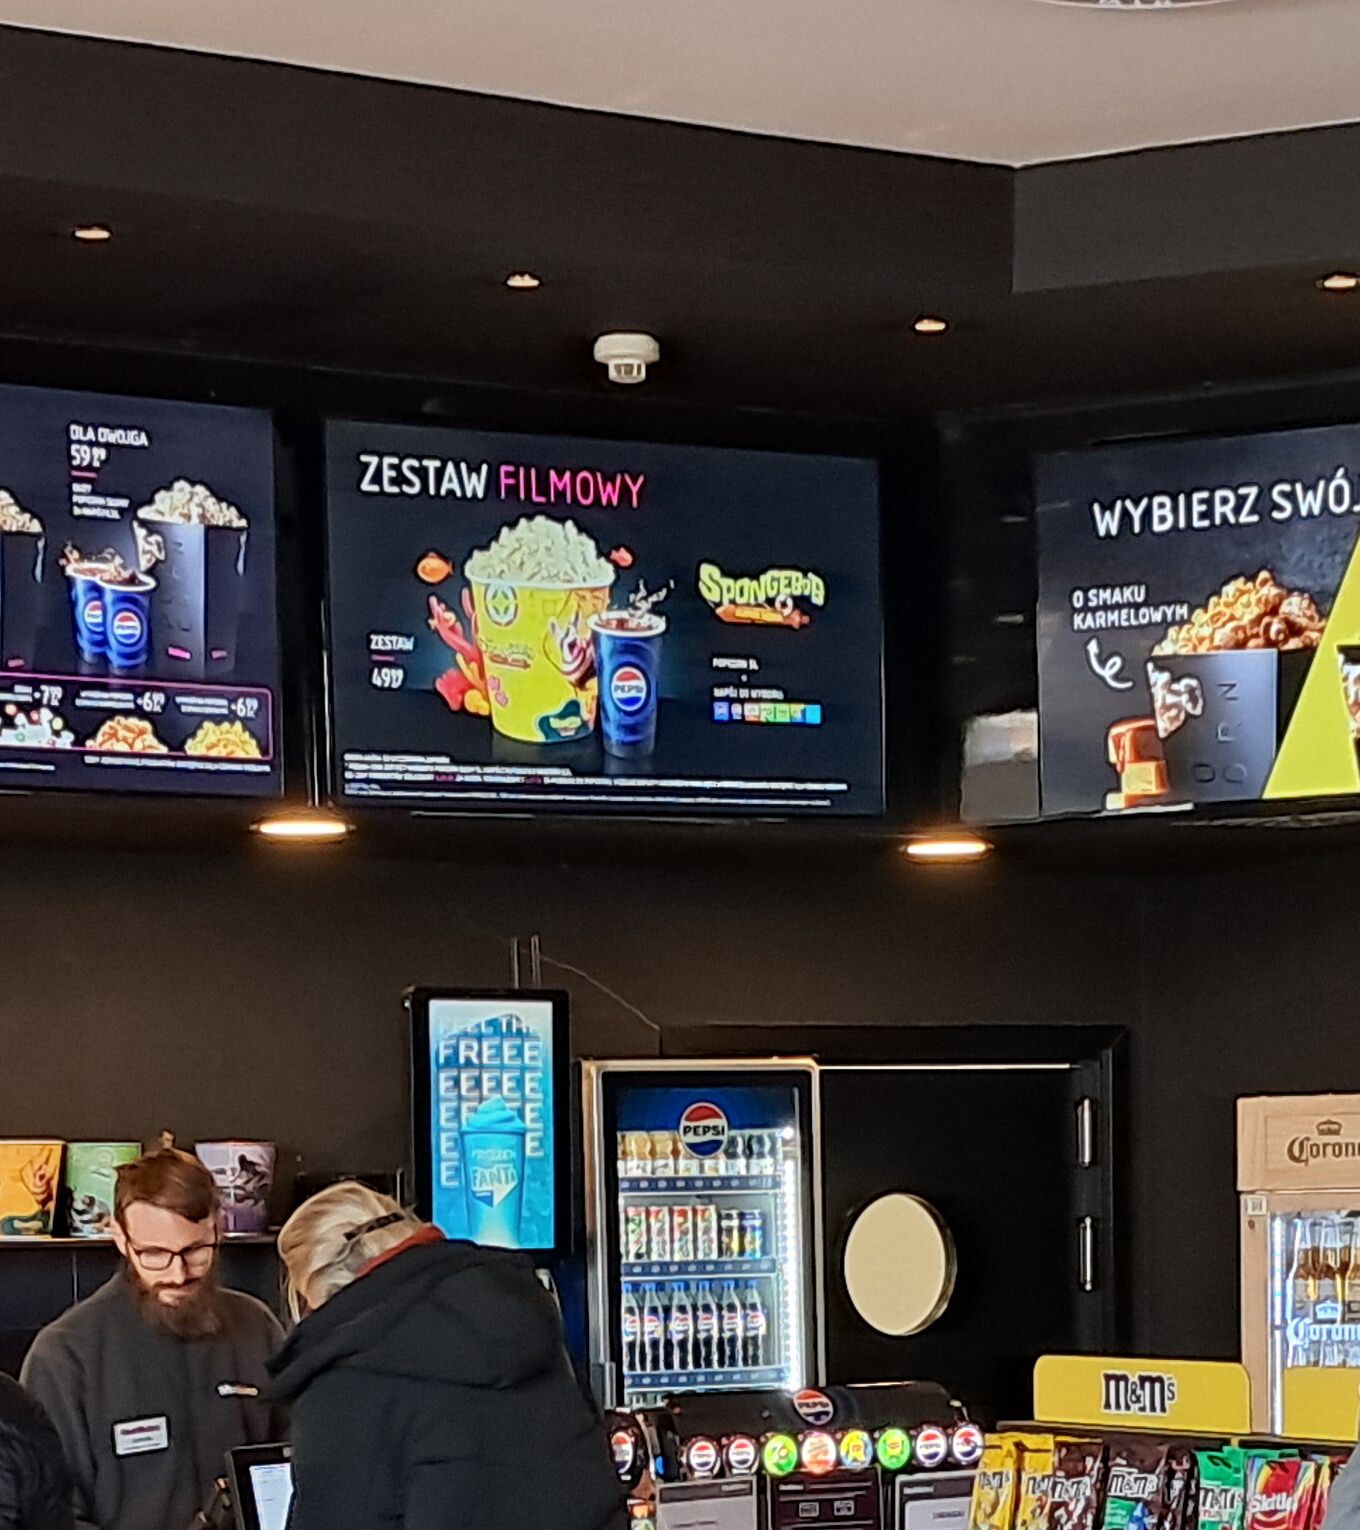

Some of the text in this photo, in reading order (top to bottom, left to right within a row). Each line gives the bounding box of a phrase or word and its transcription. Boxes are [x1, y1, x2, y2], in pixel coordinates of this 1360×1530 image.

[358, 454, 646, 509] ZESTAW FILMOWY
[1092, 484, 1261, 539] WYBIERZ
[1071, 584, 1147, 608] O SMAKU
[1072, 602, 1189, 631] KARMELOWYM
[369, 634, 415, 651] ZESTAW
[682, 1124, 726, 1137] PEPSI
